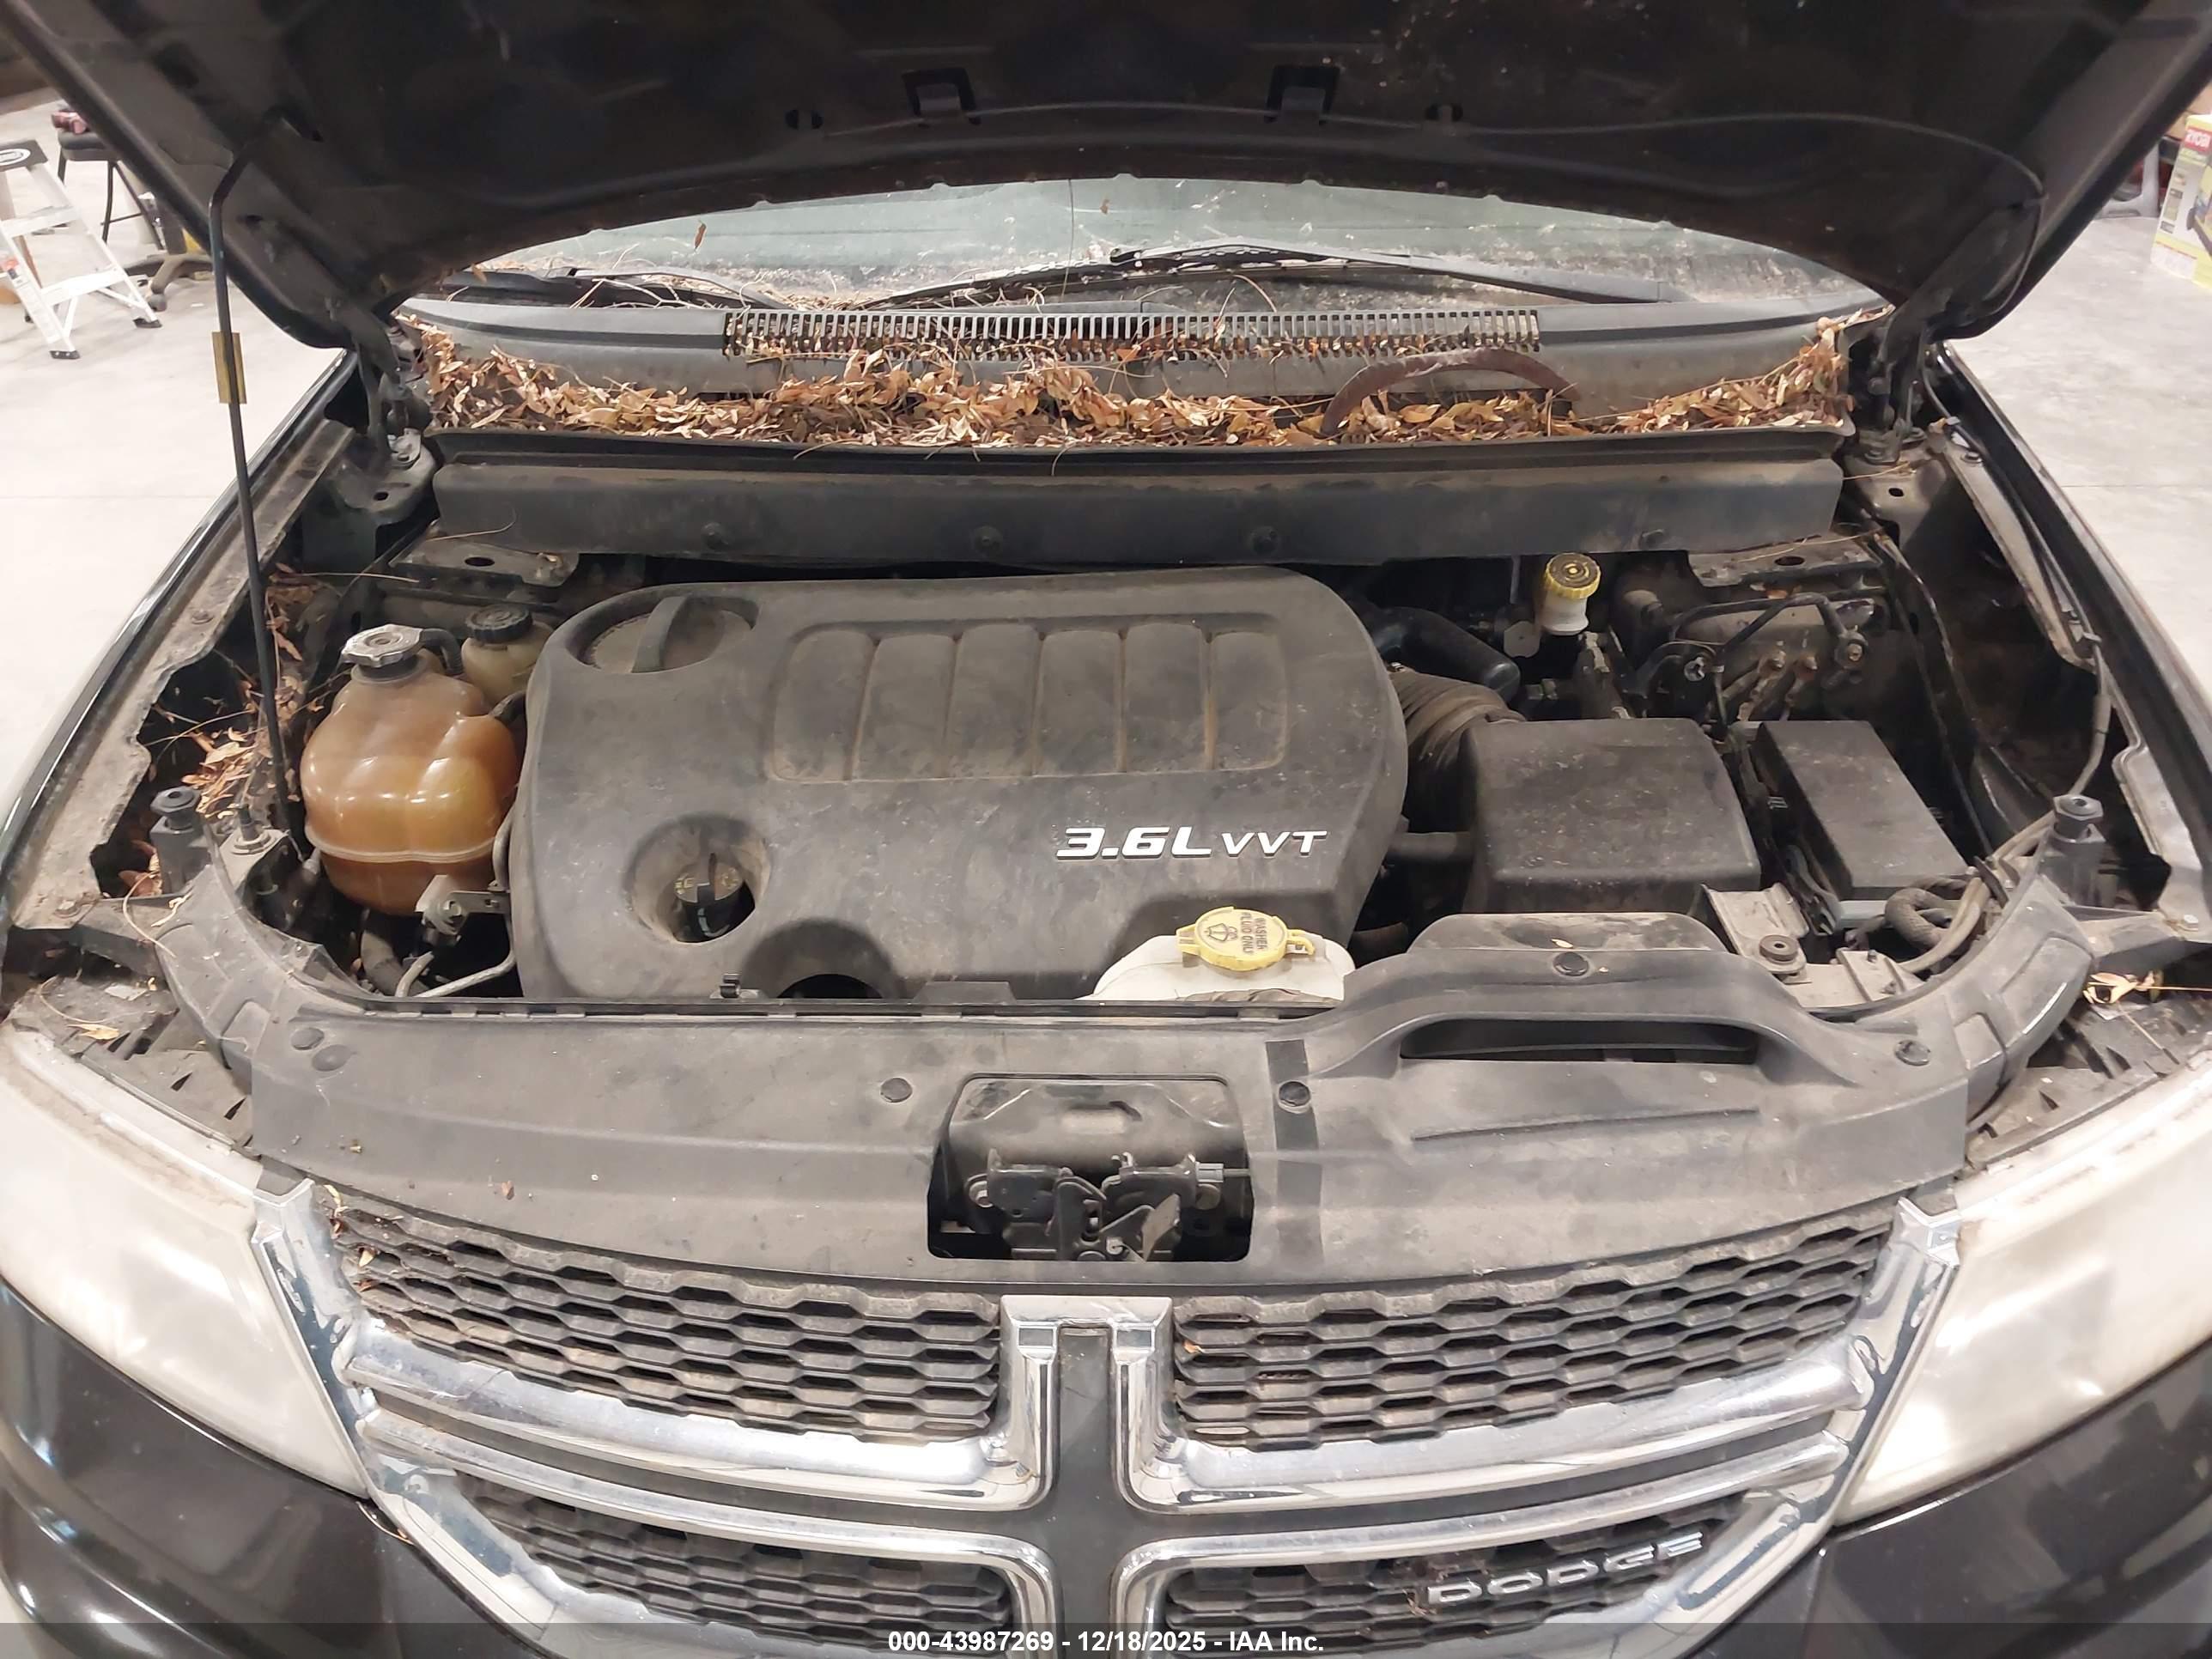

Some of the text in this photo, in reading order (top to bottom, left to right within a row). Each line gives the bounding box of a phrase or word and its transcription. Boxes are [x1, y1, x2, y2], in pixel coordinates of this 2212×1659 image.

[1056, 826, 1328, 859] 3.6L VVT
[1240, 912, 1255, 955] FLUID ONLY
[1254, 917, 1268, 950] WASHER
[1426, 1531, 1705, 1605] DODGE
